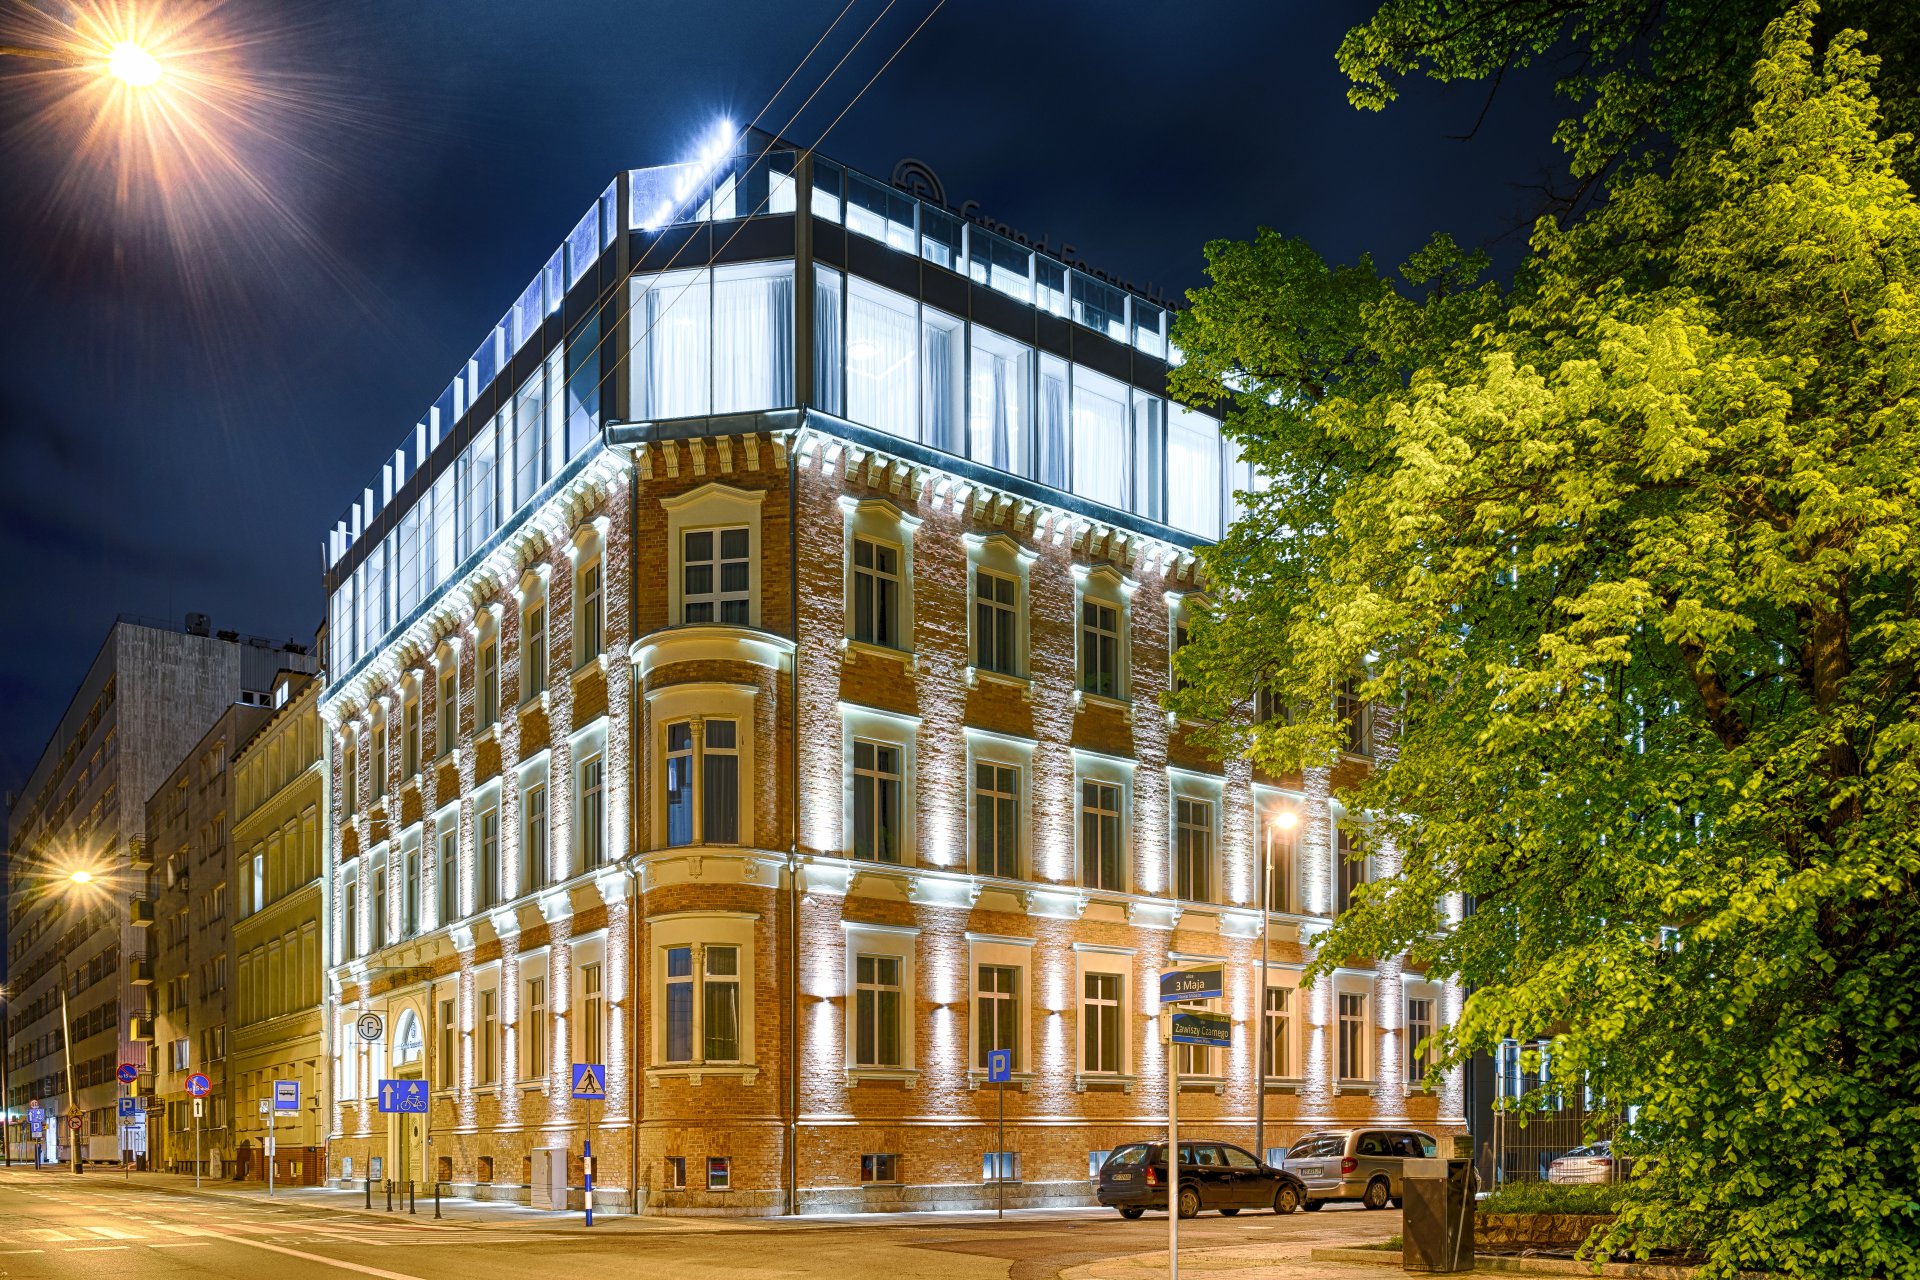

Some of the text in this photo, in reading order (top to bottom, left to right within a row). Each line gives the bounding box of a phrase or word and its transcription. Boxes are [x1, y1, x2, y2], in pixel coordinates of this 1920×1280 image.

[1175, 979, 1204, 991] 3 Maja
[368, 1022, 373, 1034] F
[1175, 1023, 1200, 1036] Zawiszy
[993, 1054, 1006, 1080] P
[122, 1099, 133, 1112] P
[33, 1122, 40, 1132] P
